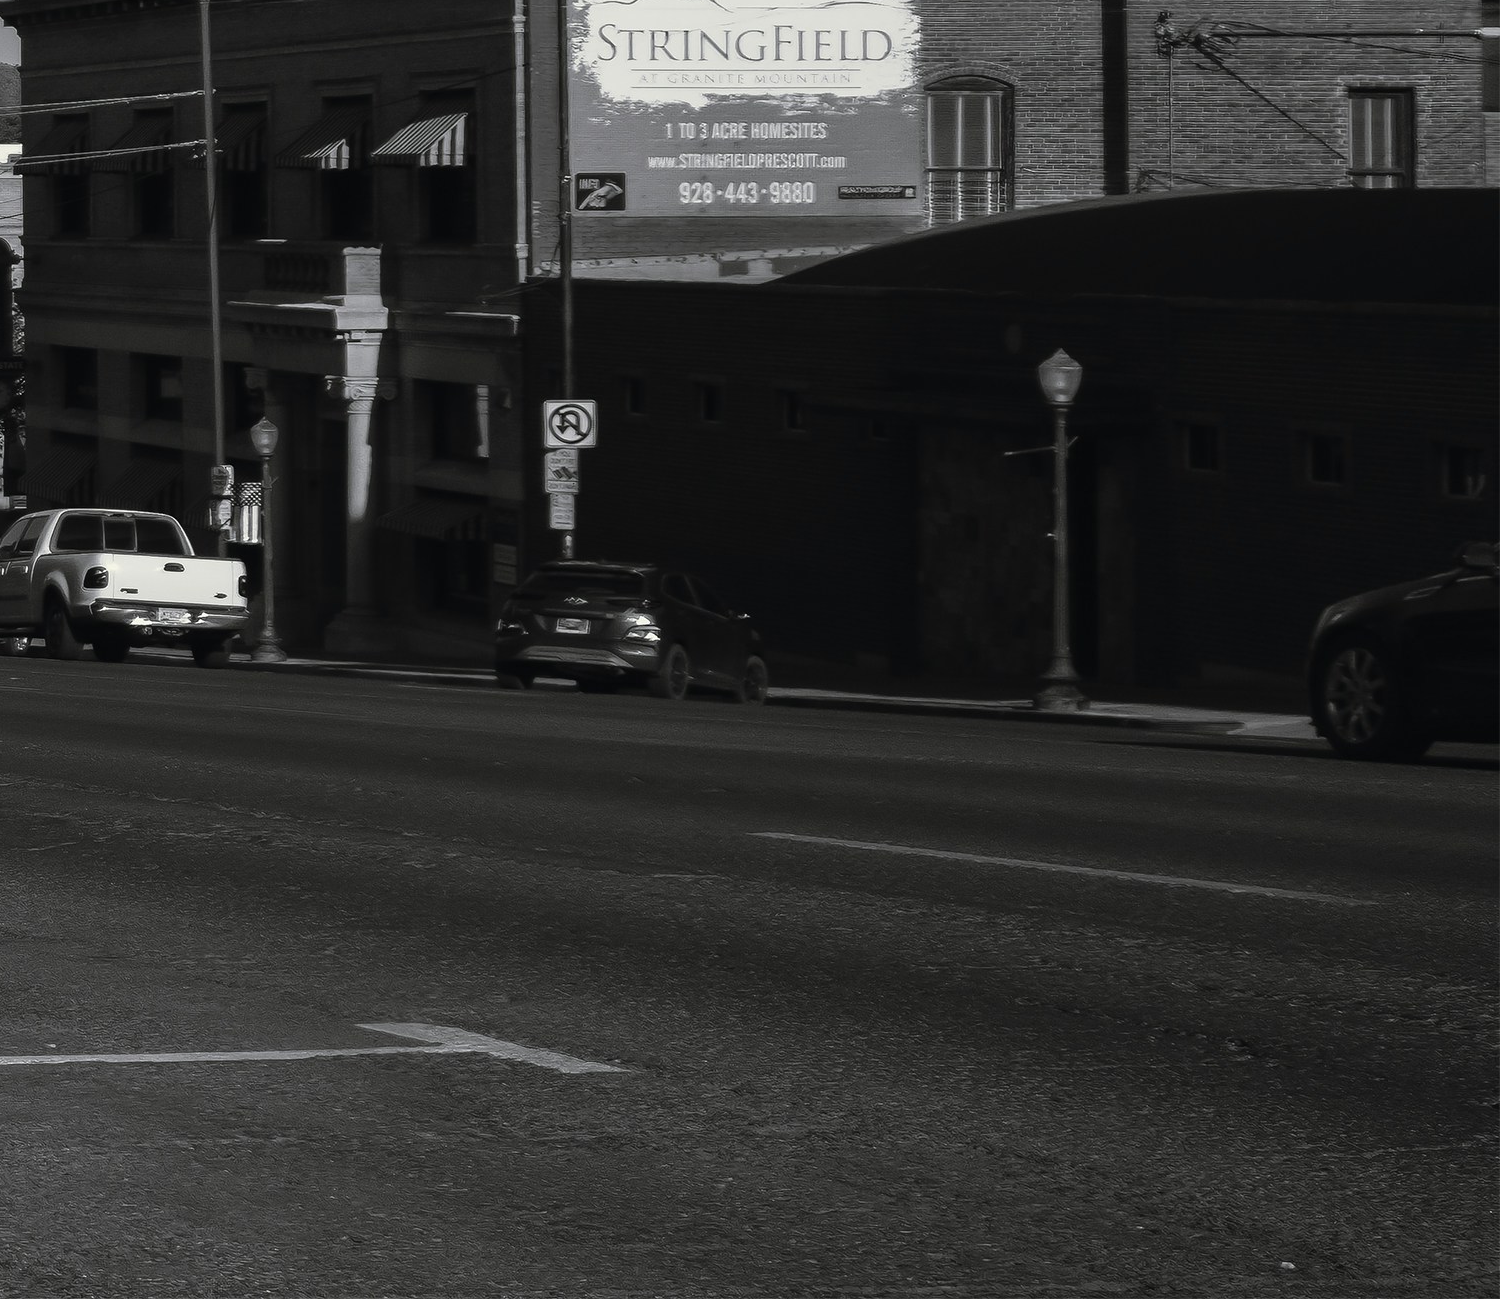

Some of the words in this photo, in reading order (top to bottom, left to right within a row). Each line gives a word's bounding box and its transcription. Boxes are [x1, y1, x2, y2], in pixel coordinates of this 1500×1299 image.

[667, 73, 745, 85] GRANITE
[754, 73, 852, 85] MOUNTAIN
[679, 123, 696, 140] TO
[711, 123, 749, 140] ACRE
[751, 123, 828, 140] HOMESITES
